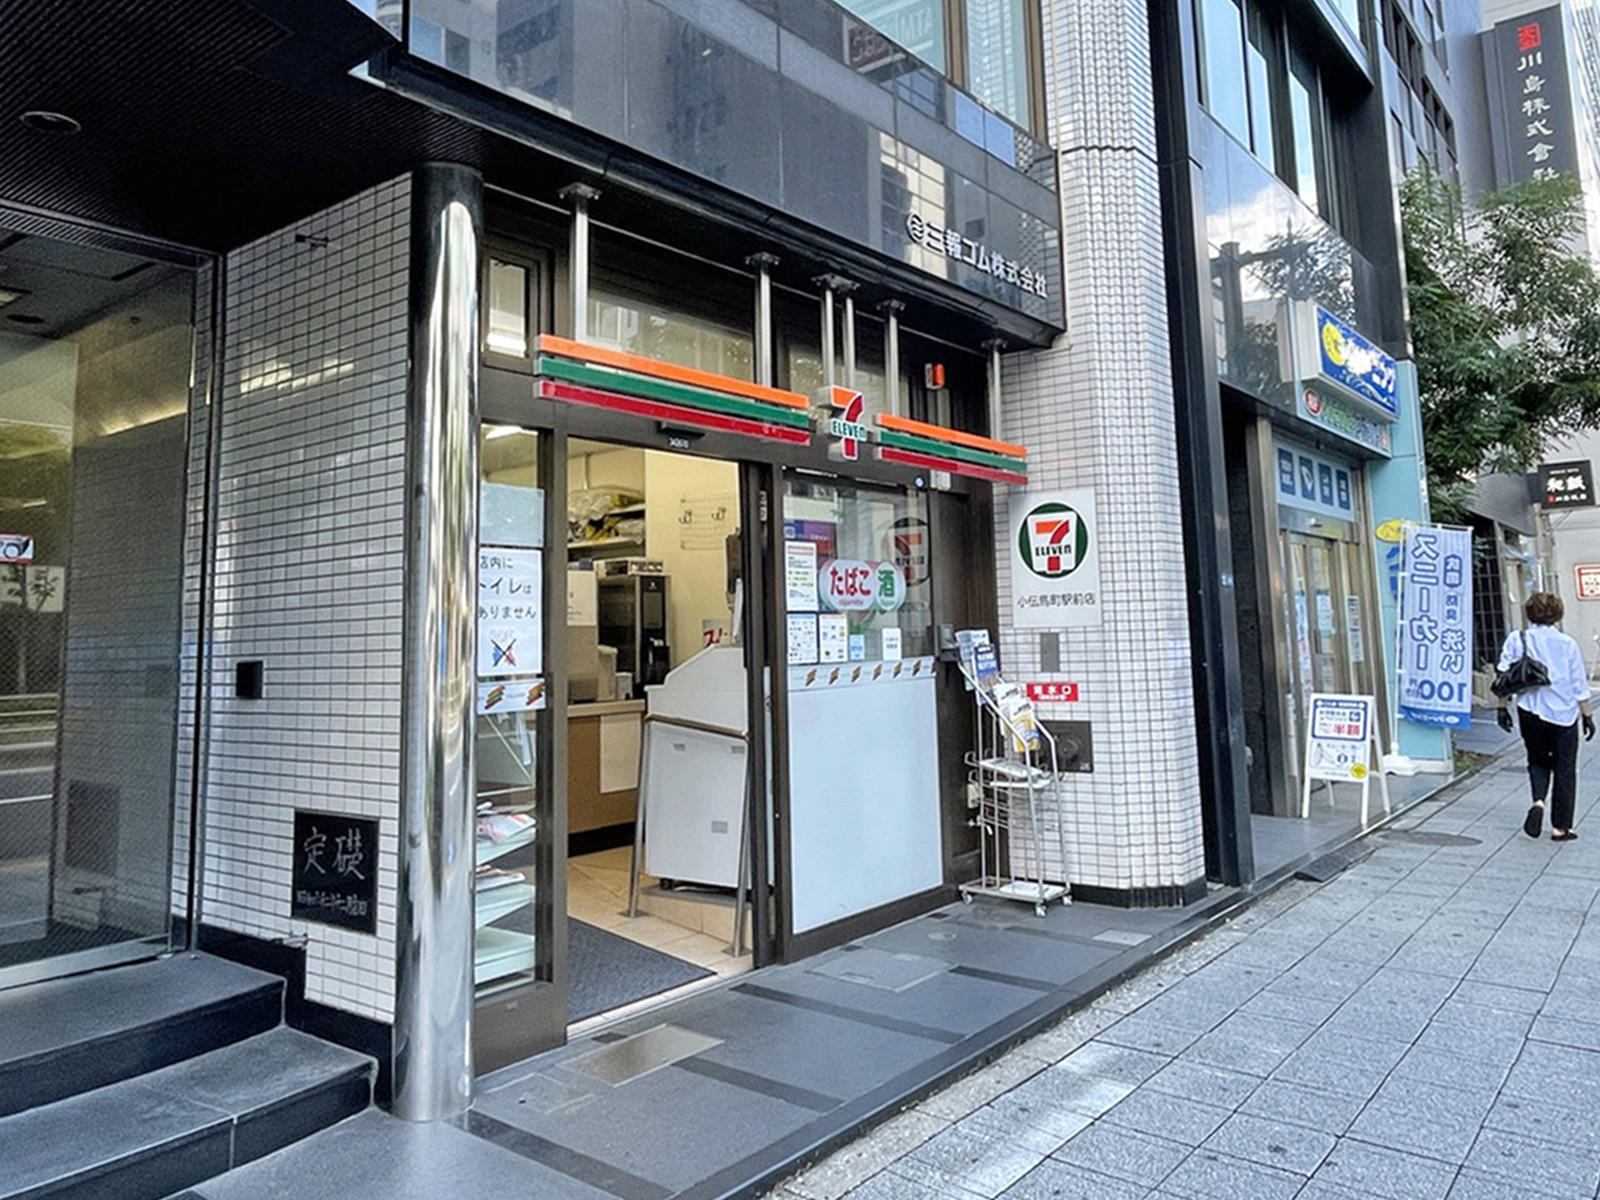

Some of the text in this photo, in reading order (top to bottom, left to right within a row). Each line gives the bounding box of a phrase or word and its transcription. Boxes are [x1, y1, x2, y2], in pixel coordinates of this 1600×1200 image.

[831, 385, 864, 461] 7
[1035, 519, 1070, 572] 7
[829, 566, 872, 597] たばこ
[878, 569, 895, 598] 酒
[479, 605, 537, 620] ありません
[303, 825, 366, 881] 定礎
